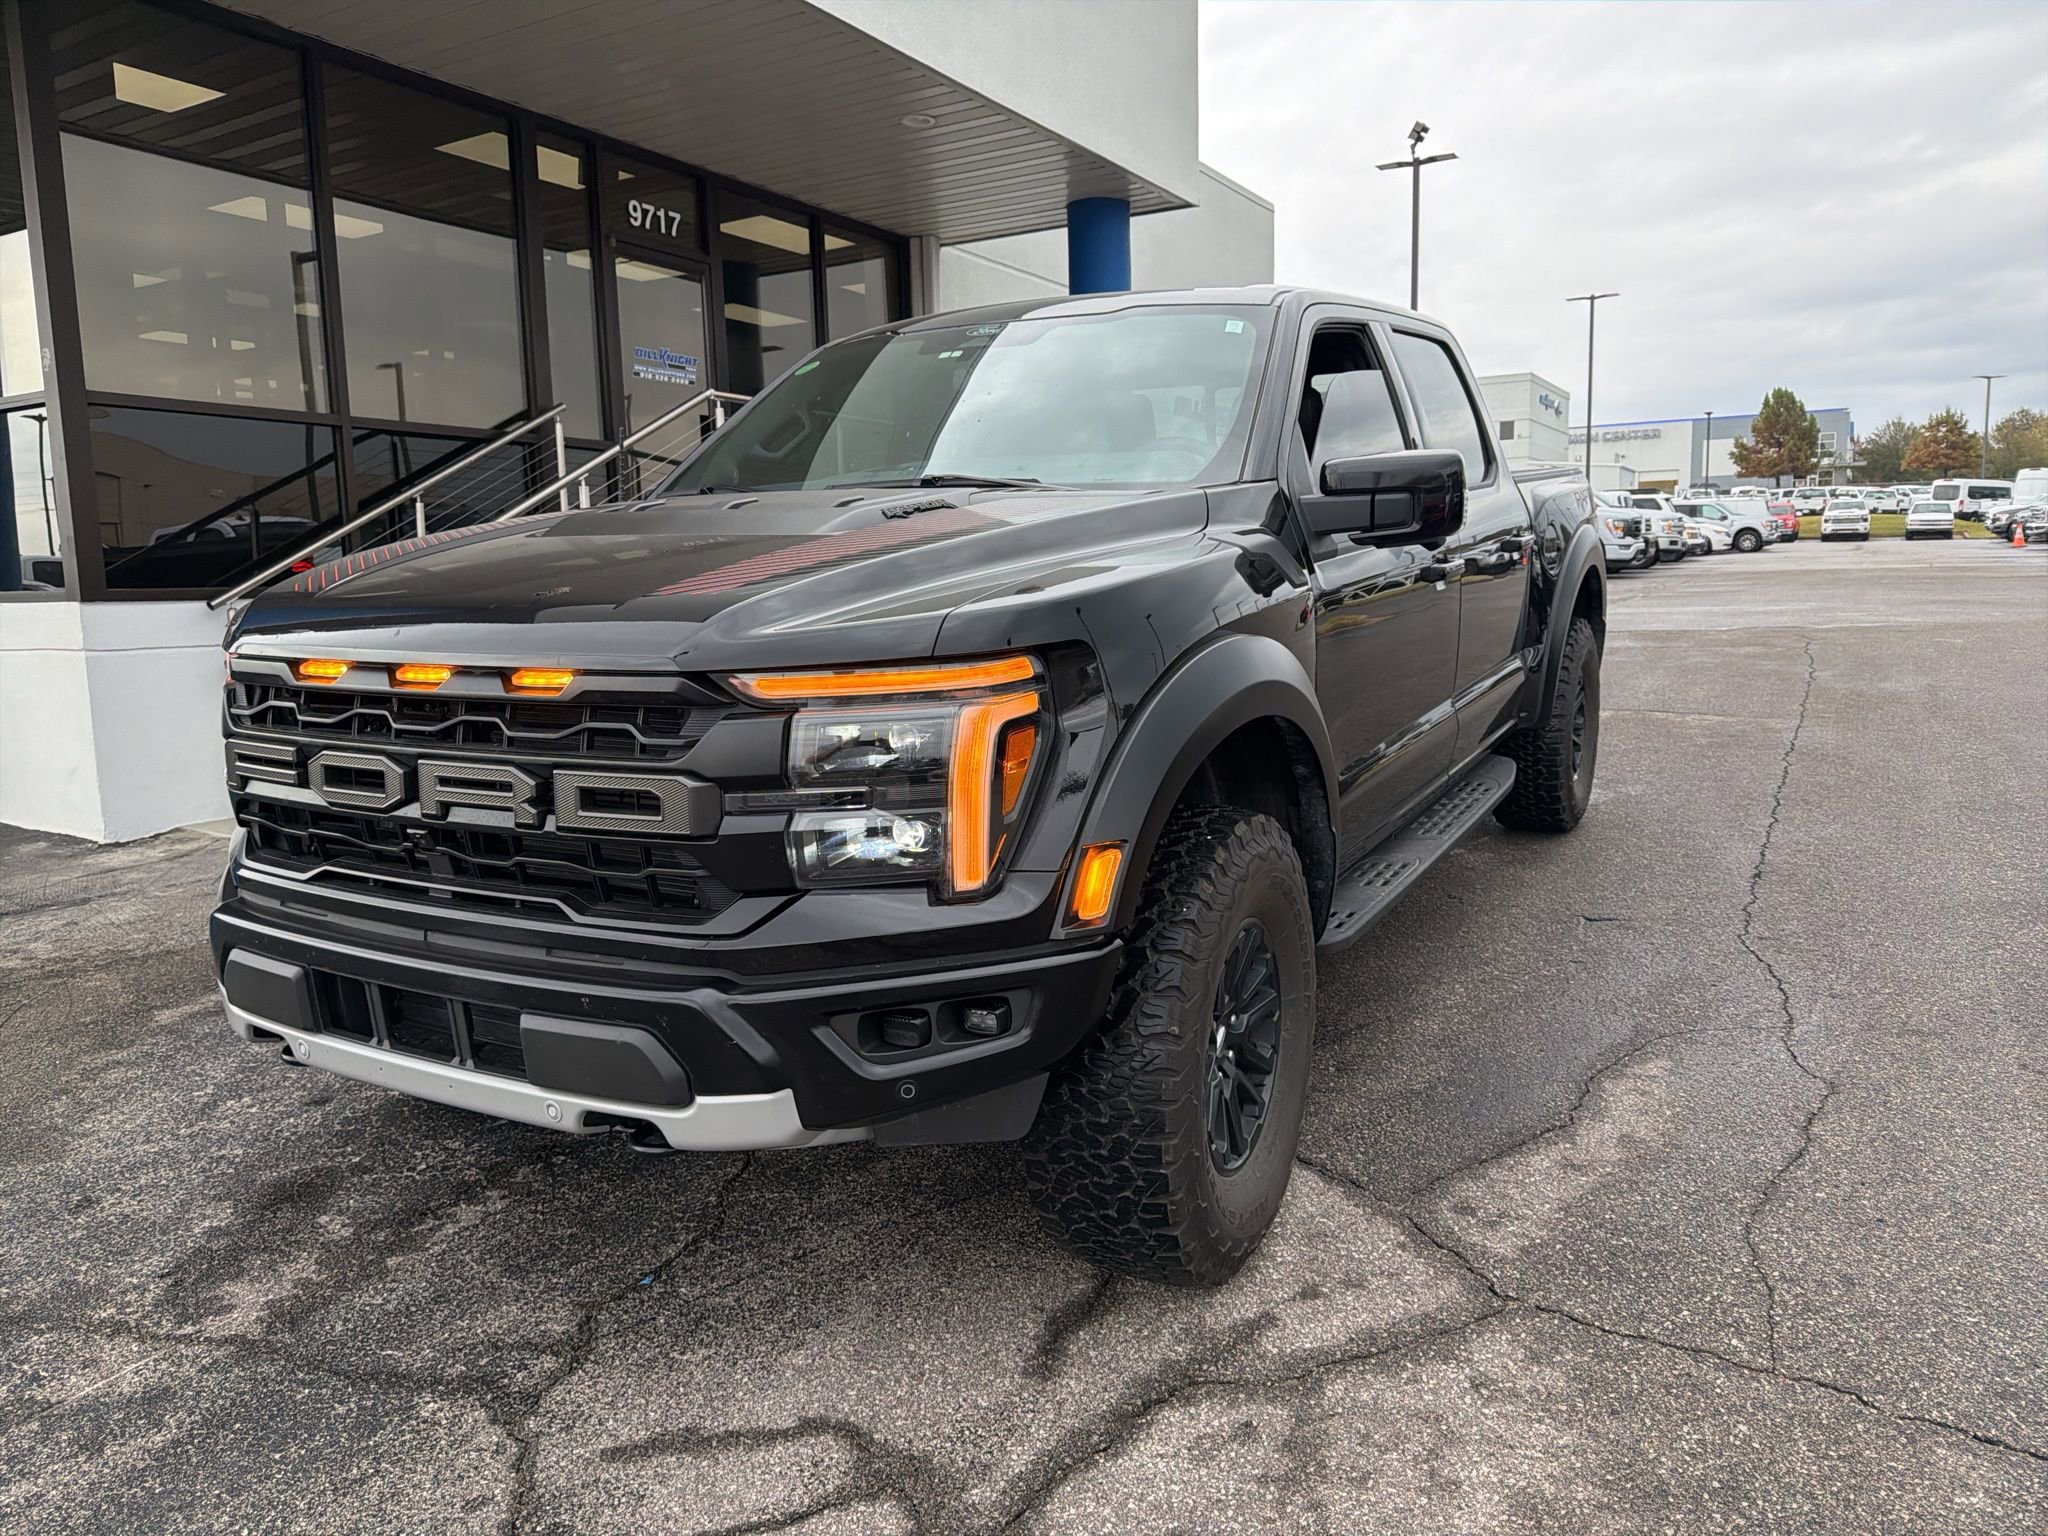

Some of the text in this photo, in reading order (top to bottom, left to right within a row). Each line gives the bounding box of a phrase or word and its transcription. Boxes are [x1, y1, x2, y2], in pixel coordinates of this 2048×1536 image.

[628, 199, 681, 237] 9717
[881, 498, 959, 519] RAPTOR
[225, 739, 722, 842] FORD
